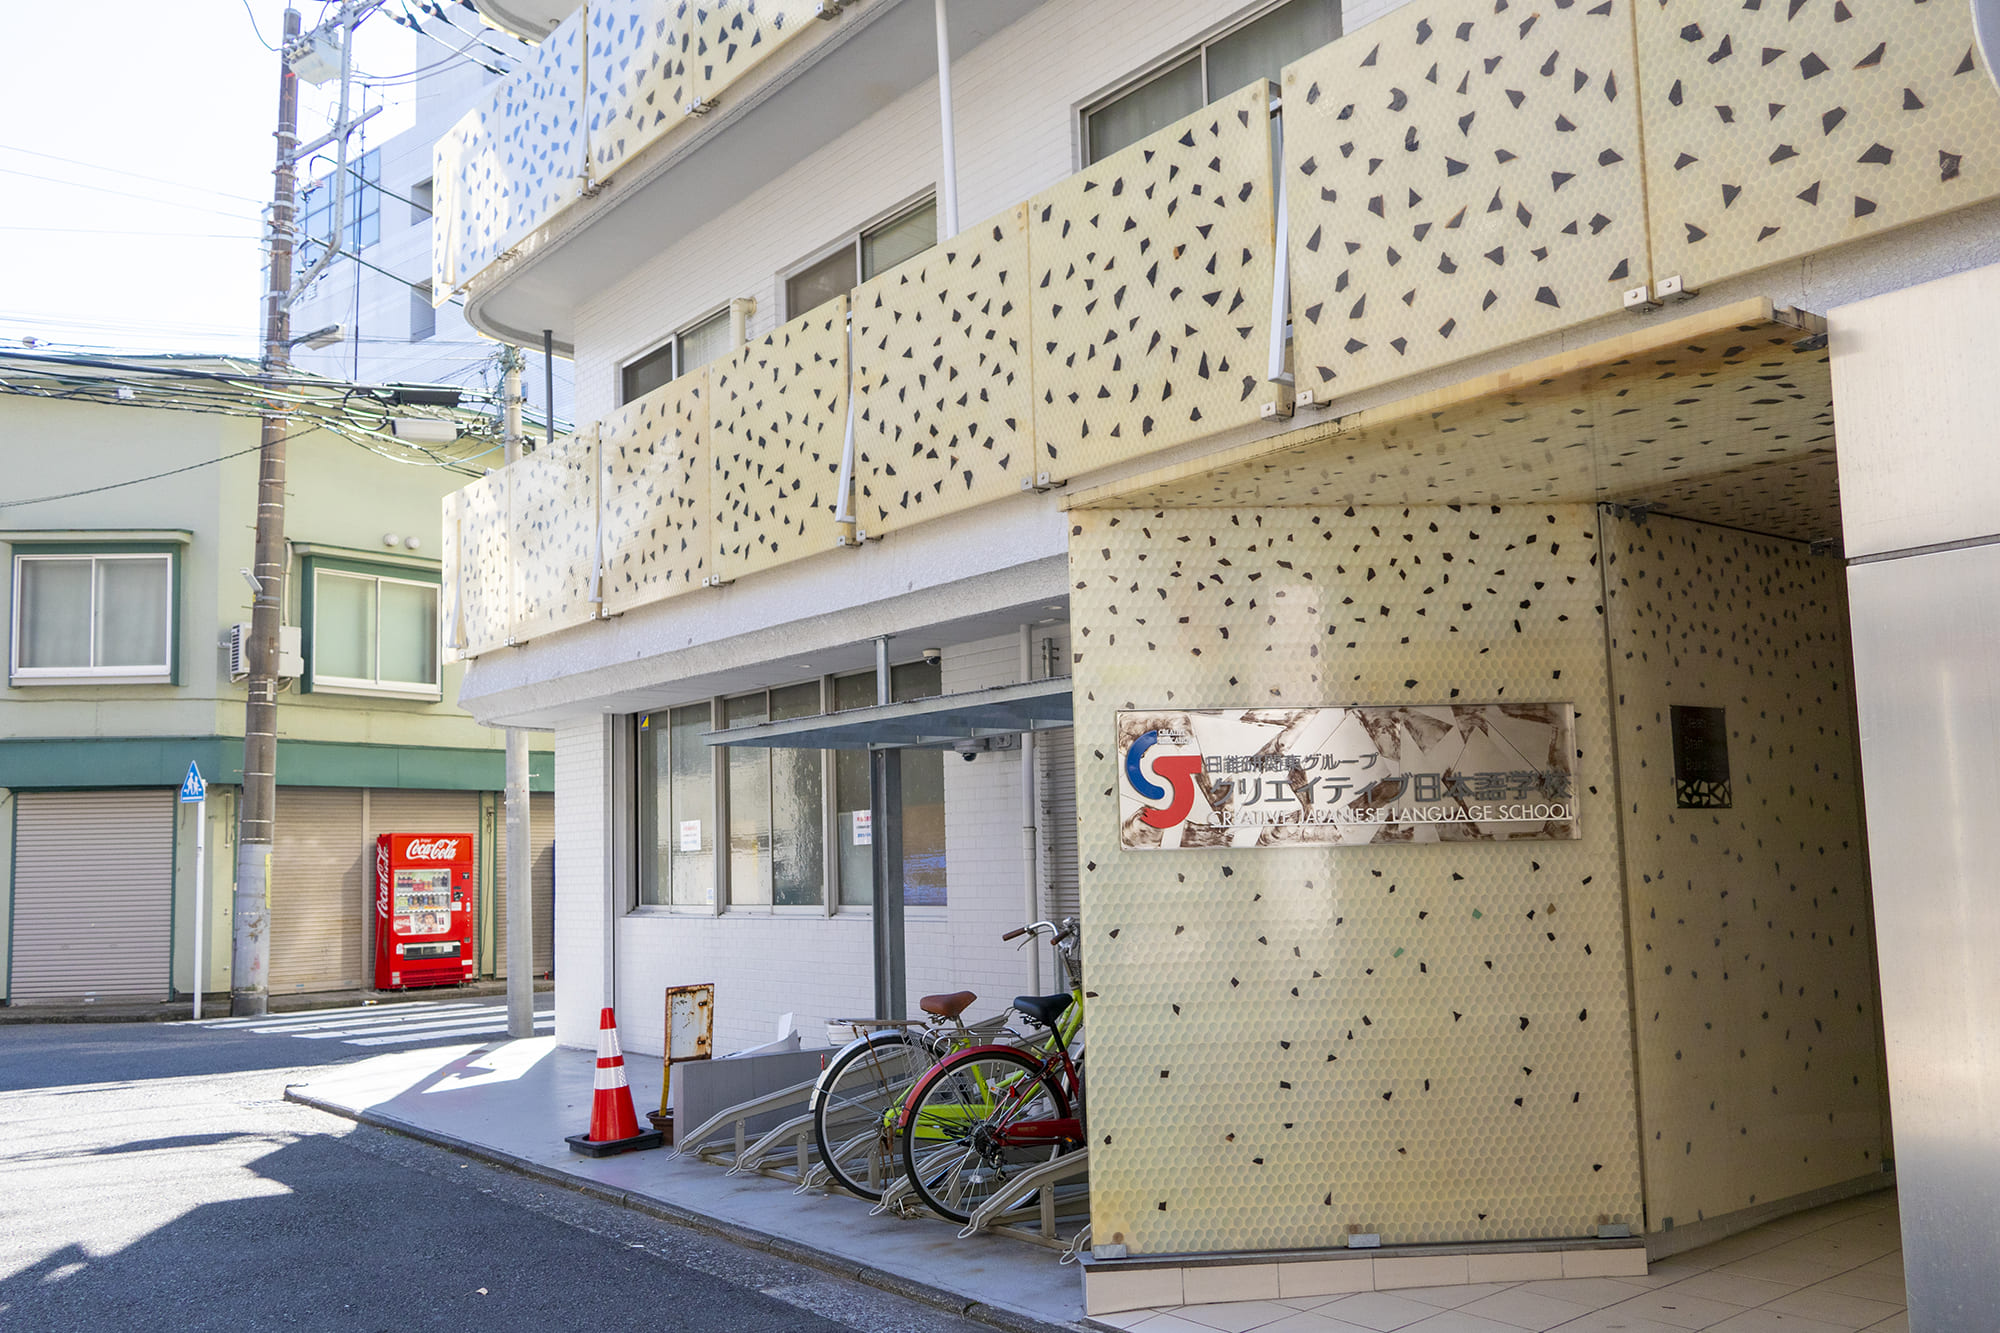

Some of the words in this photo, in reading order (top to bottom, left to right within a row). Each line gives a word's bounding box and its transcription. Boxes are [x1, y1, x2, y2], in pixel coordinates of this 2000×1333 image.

[1210, 769, 1573, 808] クリエイティブ日本語学校
[1207, 809, 1290, 827] CREATIVE
[1301, 807, 1385, 826] JAPANESE
[1393, 805, 1493, 822] LANGUAGE
[1499, 803, 1572, 820] SCHOOL
[406, 839, 459, 860] Coca-Cola
